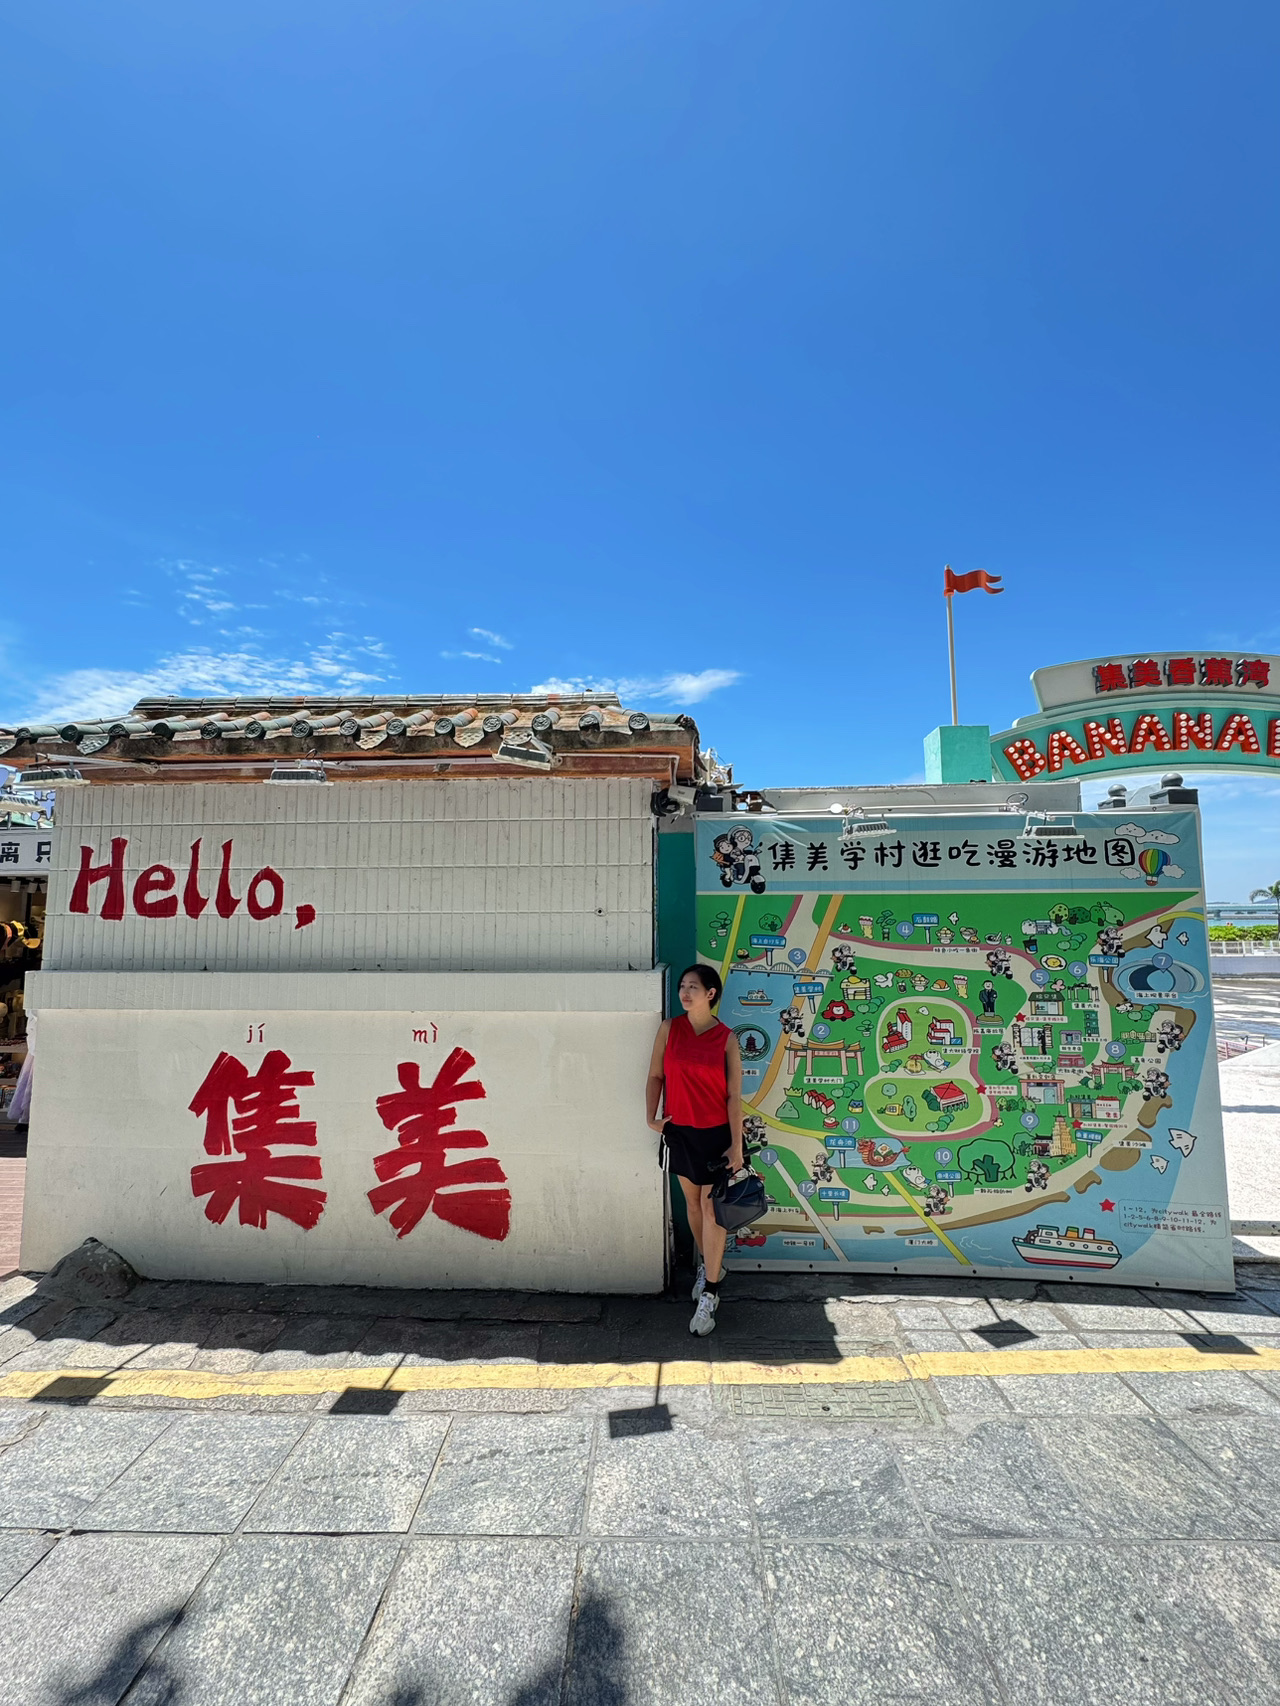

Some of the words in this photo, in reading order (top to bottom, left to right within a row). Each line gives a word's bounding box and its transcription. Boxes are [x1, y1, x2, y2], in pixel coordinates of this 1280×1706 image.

[1094, 657, 1271, 694] 集美香蕉湾
[767, 838, 1136, 872] 集美学村逛吃漫游地图
[69, 837, 317, 930] Hello,
[901, 924, 910, 934] 4
[793, 951, 802, 960] 3
[1158, 956, 1166, 966] 7
[1074, 965, 1082, 975] 6
[1036, 972, 1043, 981] 5
[817, 1026, 825, 1035] 2
[1111, 1044, 1120, 1054] 8
[846, 1120, 857, 1130] 11
[1026, 1115, 1034, 1125] 9
[188, 1047, 510, 1239] 集美
[936, 1151, 950, 1160] 10
[801, 1183, 815, 1193] 12
